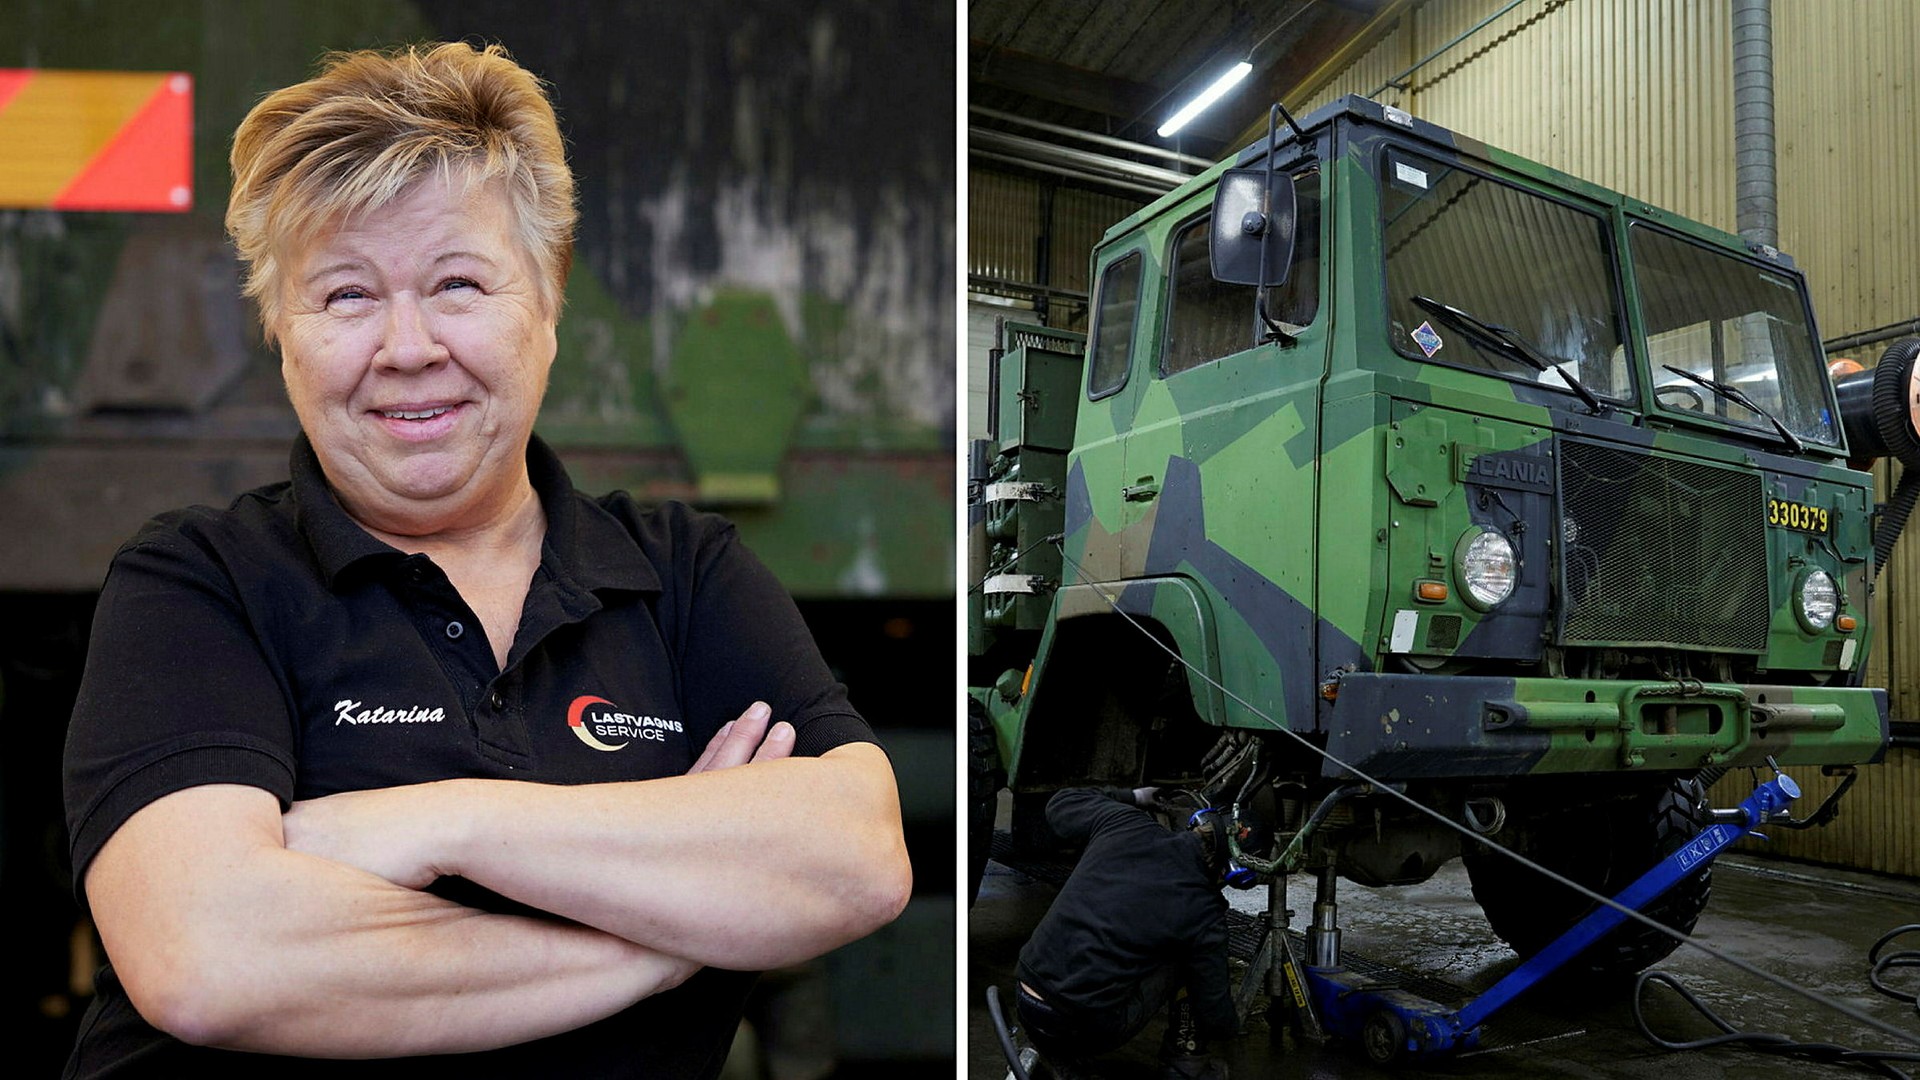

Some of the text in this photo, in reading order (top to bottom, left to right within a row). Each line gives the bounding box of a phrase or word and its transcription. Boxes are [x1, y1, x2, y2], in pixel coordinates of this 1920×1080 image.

[1463, 453, 1550, 485] SCANIA
[1769, 500, 1828, 532] 330379
[334, 699, 446, 727] Katarina
[591, 712, 684, 733] LASTVAGNS
[595, 725, 665, 742] SERVICE
